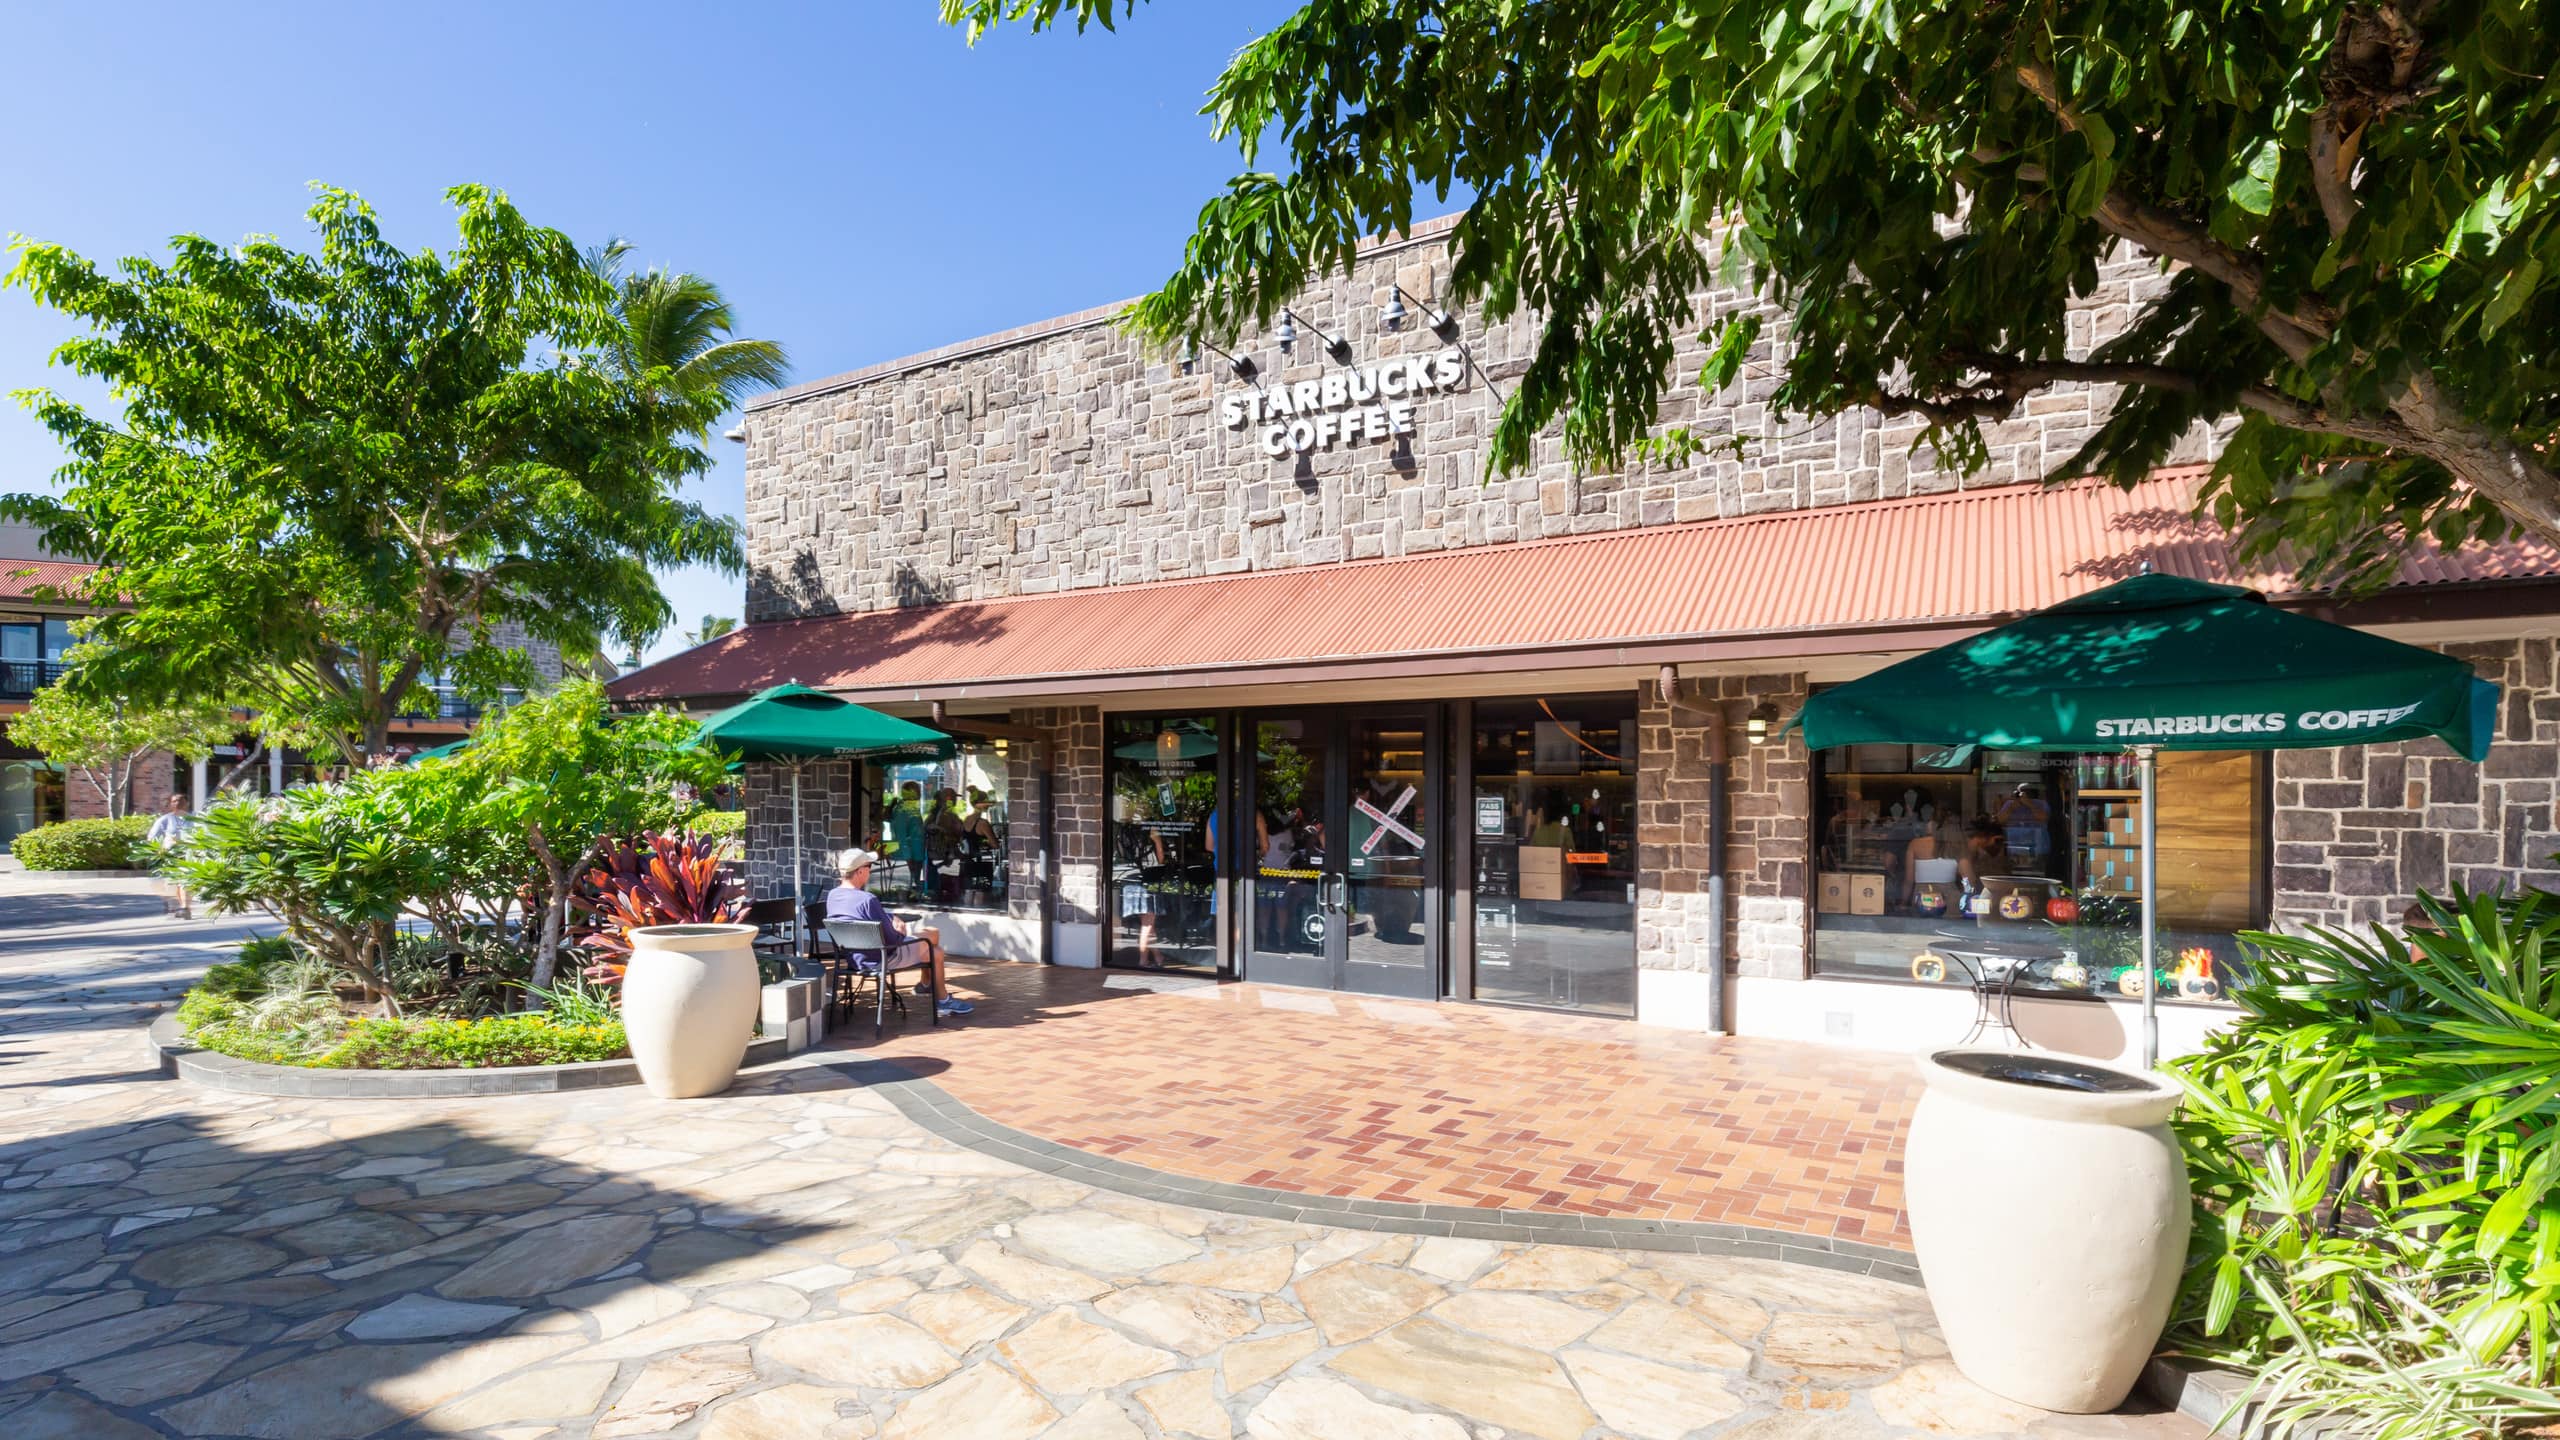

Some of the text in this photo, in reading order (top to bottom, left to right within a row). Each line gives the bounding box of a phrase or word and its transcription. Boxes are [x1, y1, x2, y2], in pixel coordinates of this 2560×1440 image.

[1221, 350, 1463, 426] STARBUCKS
[1262, 402, 1413, 456] COFFEE
[2095, 700, 2423, 737] STARBUCKS COFFEE
